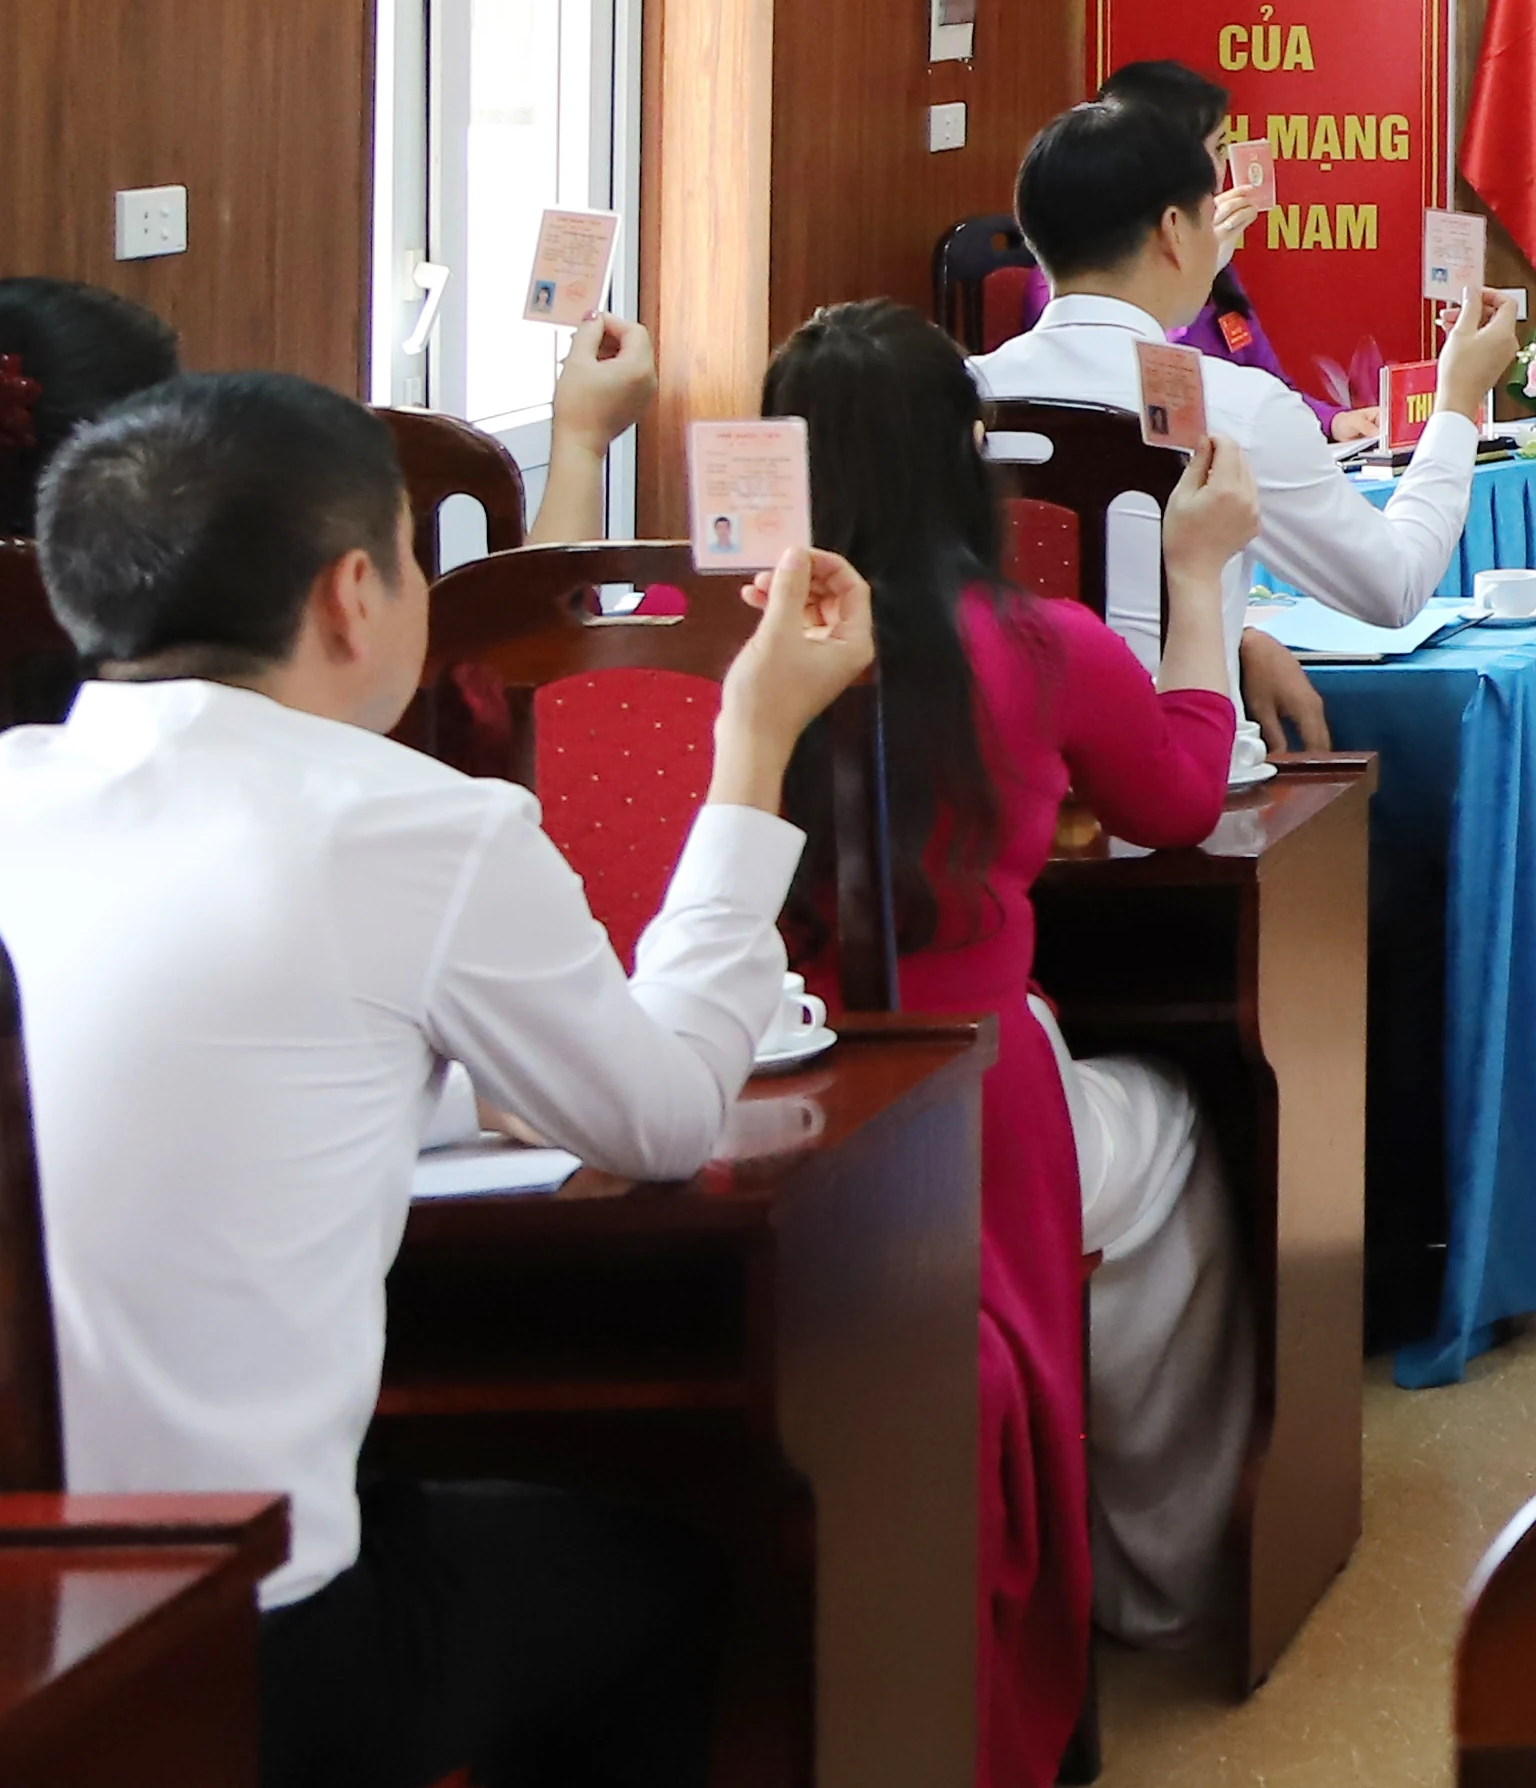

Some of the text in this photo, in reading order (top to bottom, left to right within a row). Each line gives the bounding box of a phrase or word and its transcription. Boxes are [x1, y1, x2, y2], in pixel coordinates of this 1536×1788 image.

[1218, 4, 1315, 72] CỦA
[1267, 114, 1410, 170] MẠNG
[1267, 204, 1379, 250] NAM
